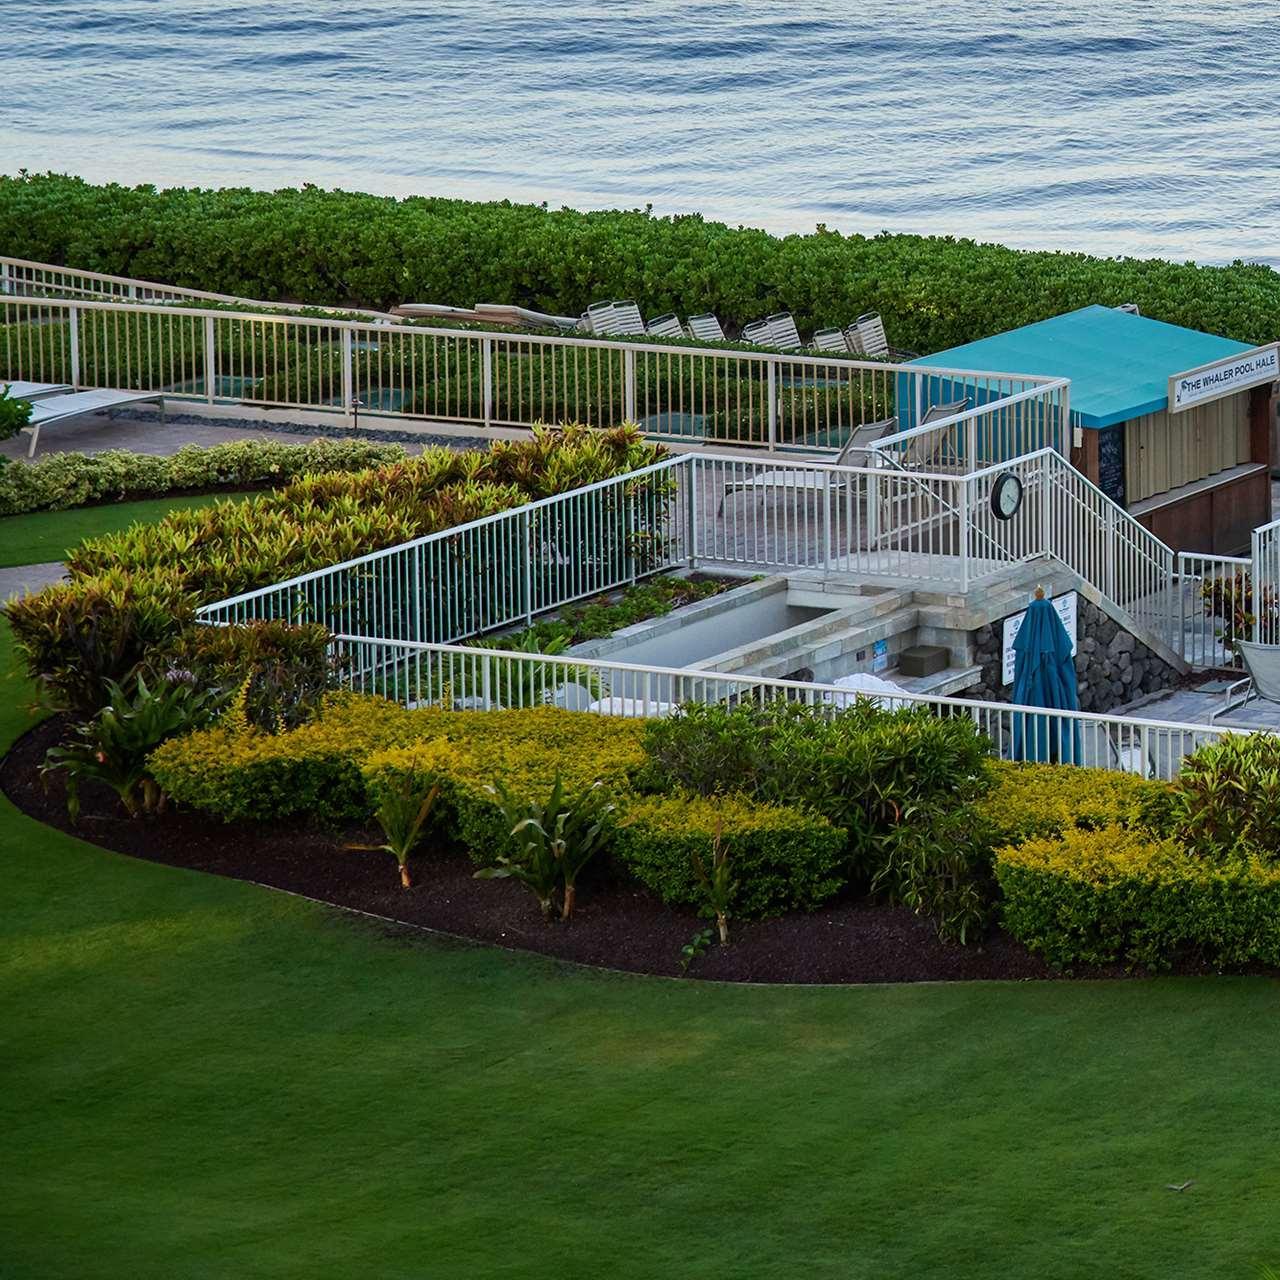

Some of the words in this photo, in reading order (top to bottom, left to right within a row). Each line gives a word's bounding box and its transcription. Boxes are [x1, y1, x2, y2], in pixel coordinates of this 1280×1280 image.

[1187, 378, 1201, 392] THE
[1203, 368, 1233, 387] WHALER
[1234, 363, 1255, 377] POOL
[1256, 355, 1276, 370] HALE
